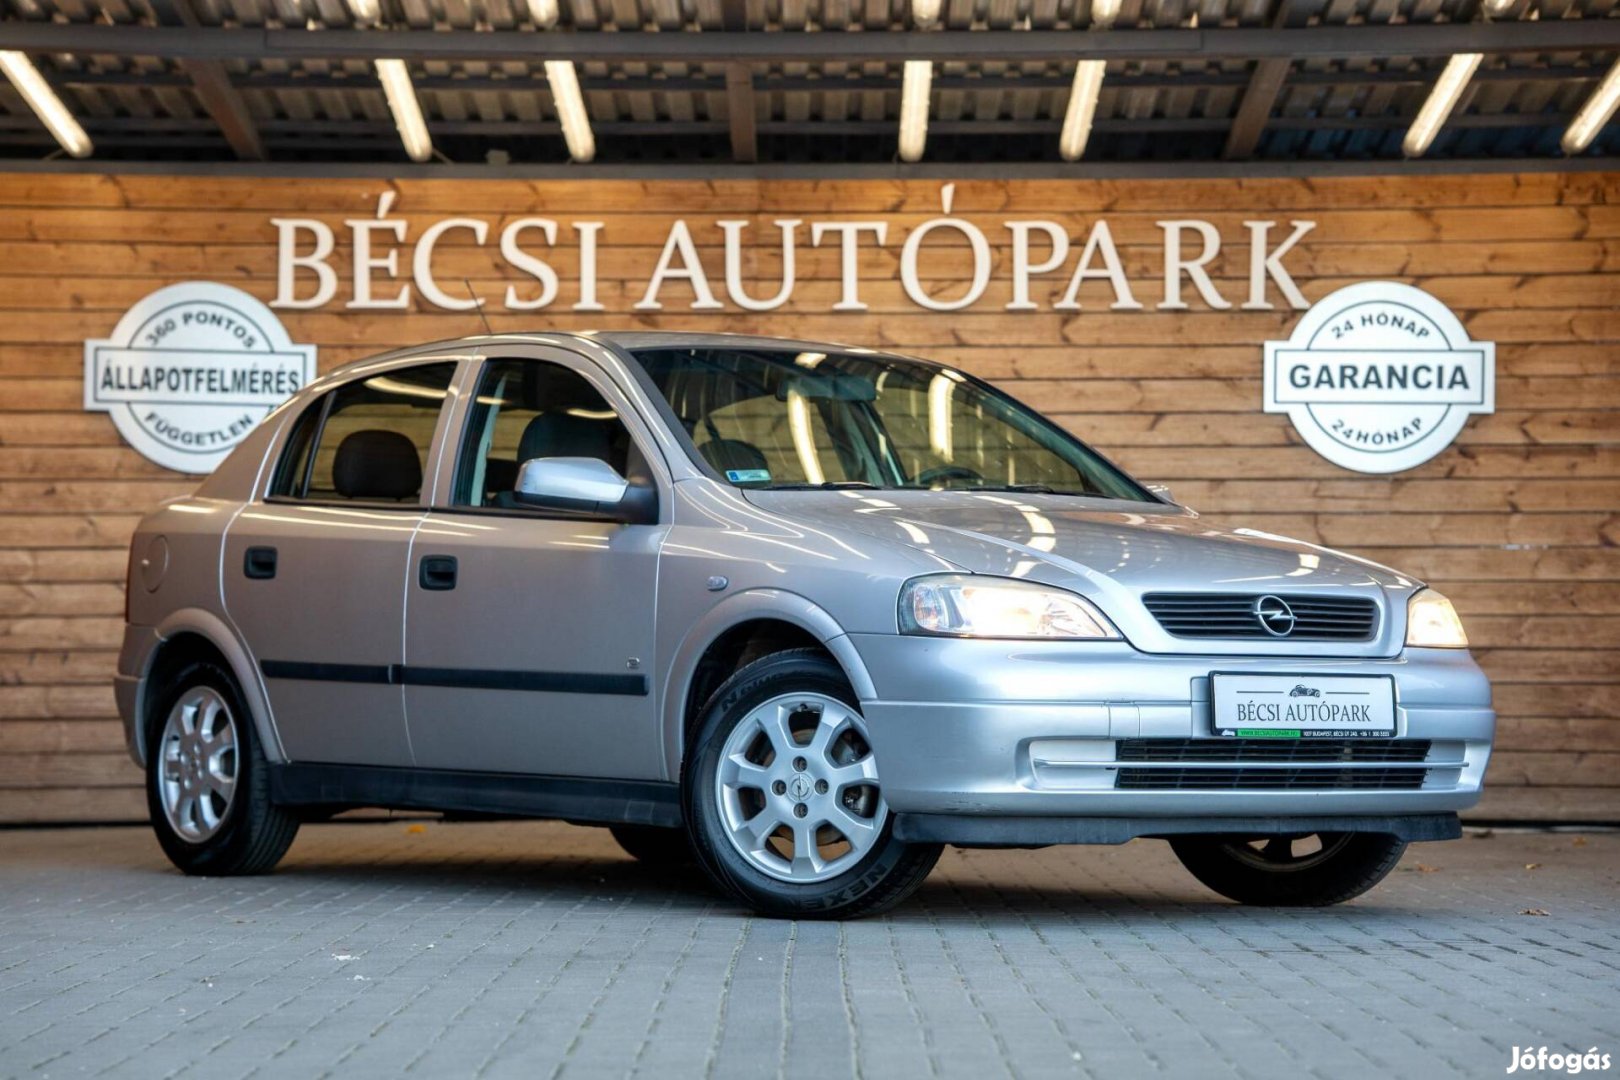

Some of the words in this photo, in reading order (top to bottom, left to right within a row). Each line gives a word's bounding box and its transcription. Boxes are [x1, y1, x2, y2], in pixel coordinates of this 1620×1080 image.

[269, 190, 604, 311] BÉCSI
[633, 183, 1316, 311] AUTÓPARK
[145, 320, 177, 346] 360
[182, 311, 256, 349] PONTOS
[1331, 320, 1354, 340] 24
[1361, 311, 1430, 340] HÓNAP
[101, 359, 299, 395] ÁLLAPOTFELMÉRÉS
[1289, 364, 1470, 390] GARANCIA
[145, 411, 254, 447] FÜGGETLEN
[1237, 700, 1281, 722] BÉCSI
[1285, 701, 1371, 722] AUTÓPARK
